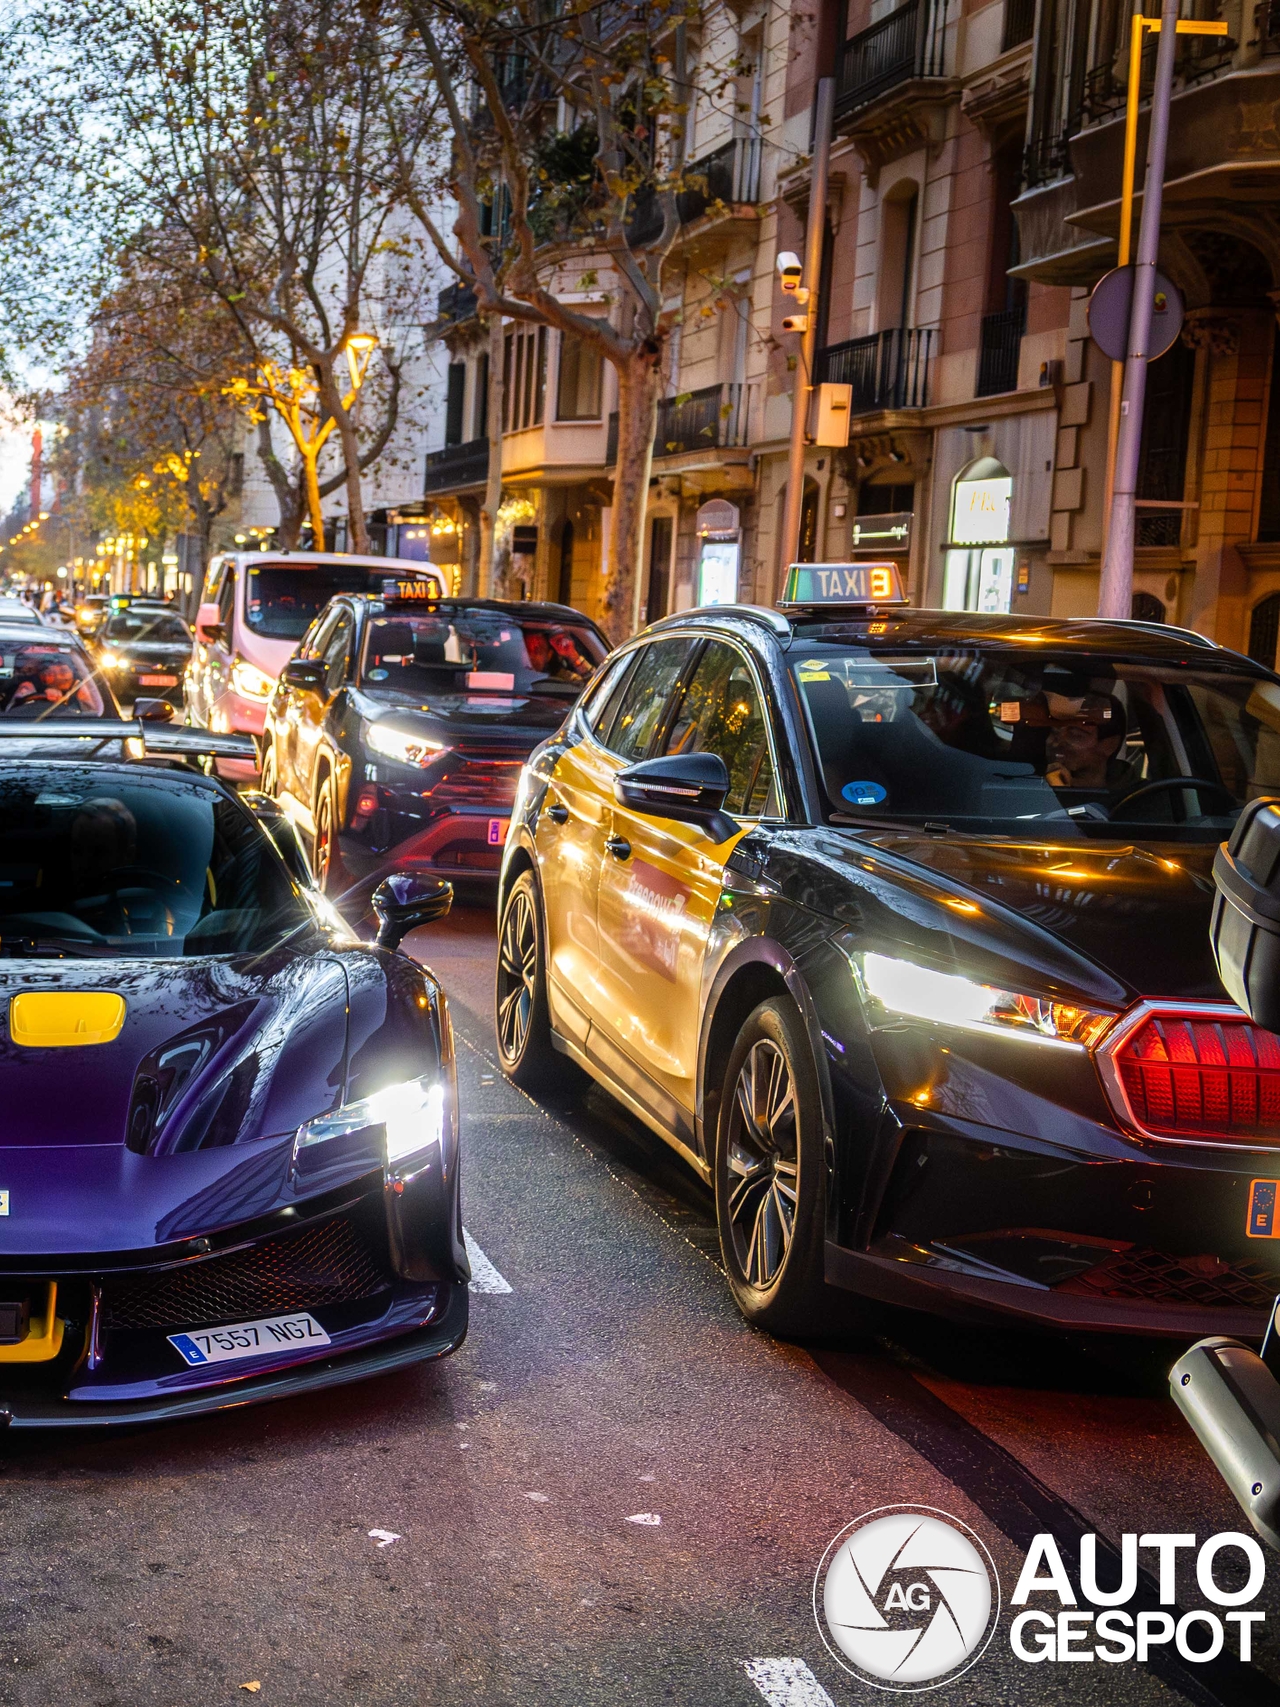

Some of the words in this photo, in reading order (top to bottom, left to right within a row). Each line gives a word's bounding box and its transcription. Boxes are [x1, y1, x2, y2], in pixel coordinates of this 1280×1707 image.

[397, 581, 426, 598] TAXI
[427, 581, 439, 599] 1
[817, 570, 866, 597] TAXI
[1256, 1213, 1268, 1227] E
[194, 1328, 261, 1354] 7557
[265, 1318, 323, 1343] NGZ
[189, 1350, 200, 1359] E
